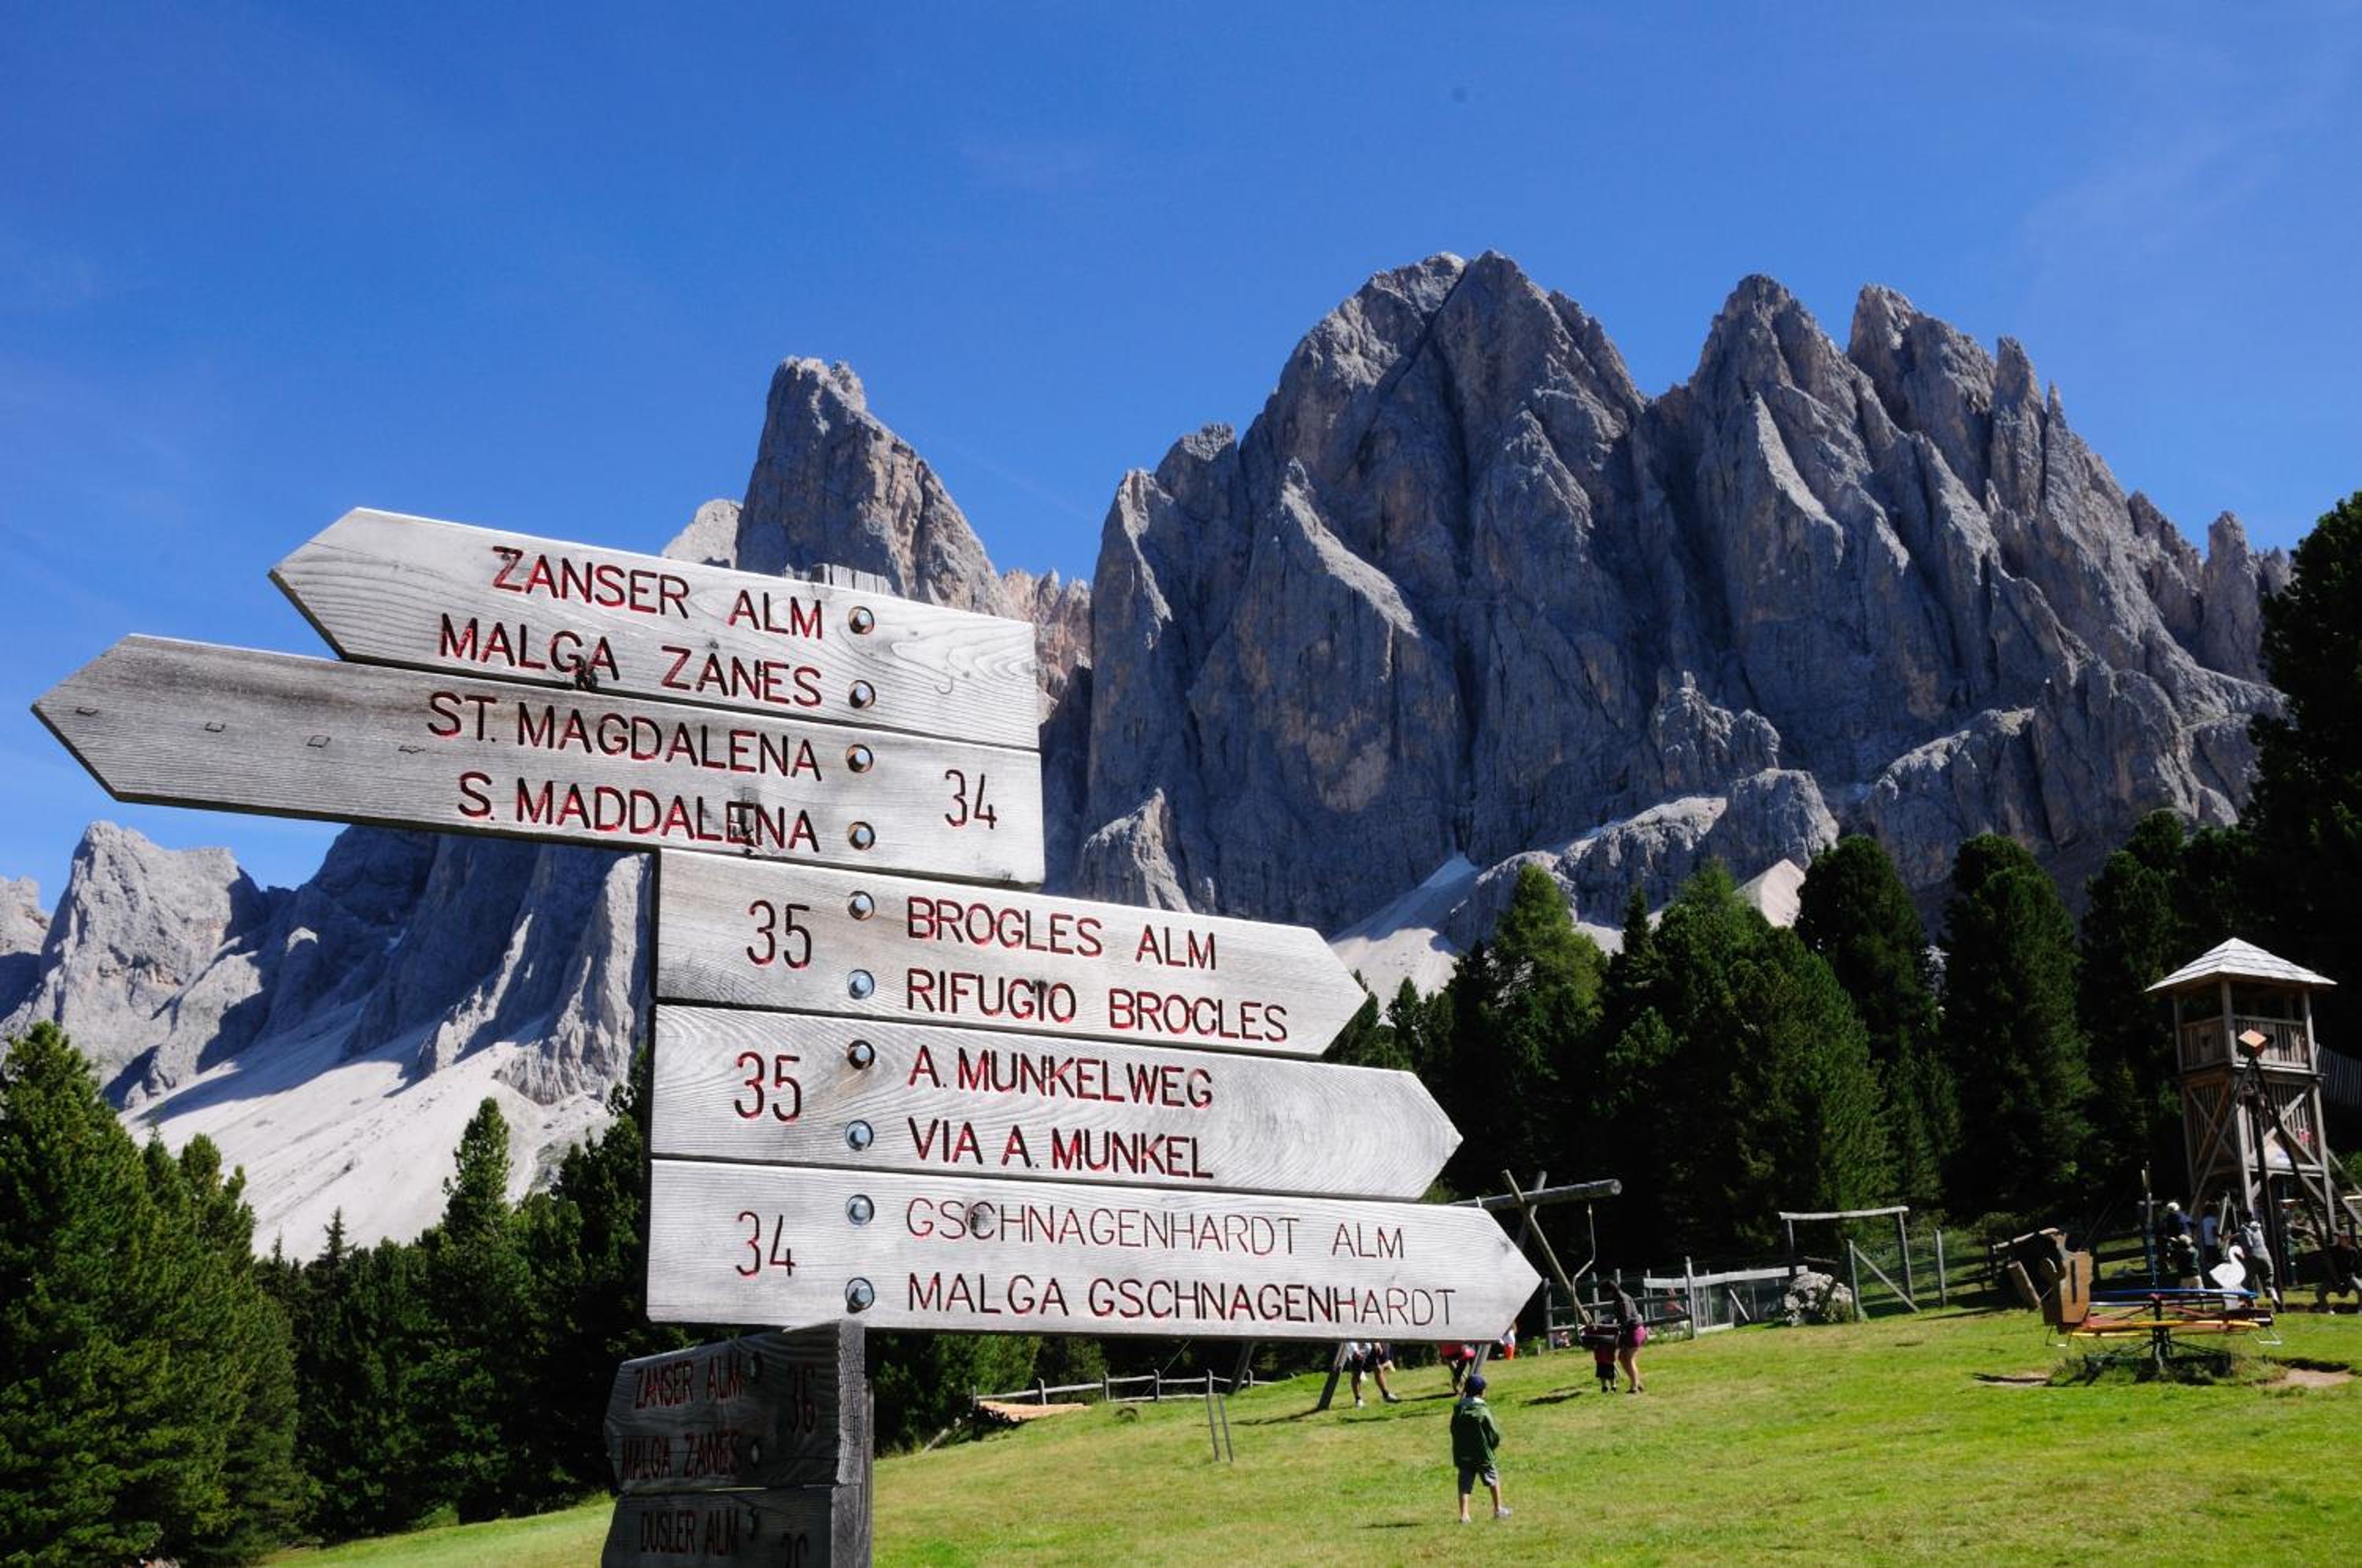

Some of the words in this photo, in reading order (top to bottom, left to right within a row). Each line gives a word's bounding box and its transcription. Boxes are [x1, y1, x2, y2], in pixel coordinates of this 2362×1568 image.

[491, 545, 689, 619] ZANSER
[728, 590, 824, 640] ALM
[439, 612, 620, 681] MALGA
[660, 644, 824, 707] ZANES
[426, 690, 498, 743] ST.
[517, 701, 823, 782] MAGDALENA
[457, 771, 495, 821] S.
[516, 777, 820, 852] MADDALENA
[944, 768, 998, 830] 34
[746, 900, 812, 969] 35
[907, 896, 1103, 957] BROGLES
[1135, 923, 1216, 971] ALM
[906, 967, 1077, 1023] RIFUGIO
[734, 1051, 802, 1122] 35
[907, 1045, 947, 1089] A.
[957, 1046, 1213, 1108] MUNKELWEG
[907, 1116, 983, 1165] VIA
[1001, 1124, 1040, 1169] A.
[1051, 1126, 1214, 1179] MUNKEL
[735, 1210, 797, 1278] 34
[906, 1197, 1300, 1256] GSCHNAGENHARDT
[1331, 1222, 1405, 1259] ALM
[908, 1272, 1069, 1317] MALGA
[1088, 1277, 1457, 1326] GSCHNAGENHARDT
[633, 1359, 694, 1410] ZANSER
[706, 1350, 745, 1400] ALM
[705, 1507, 740, 1555] ALM
